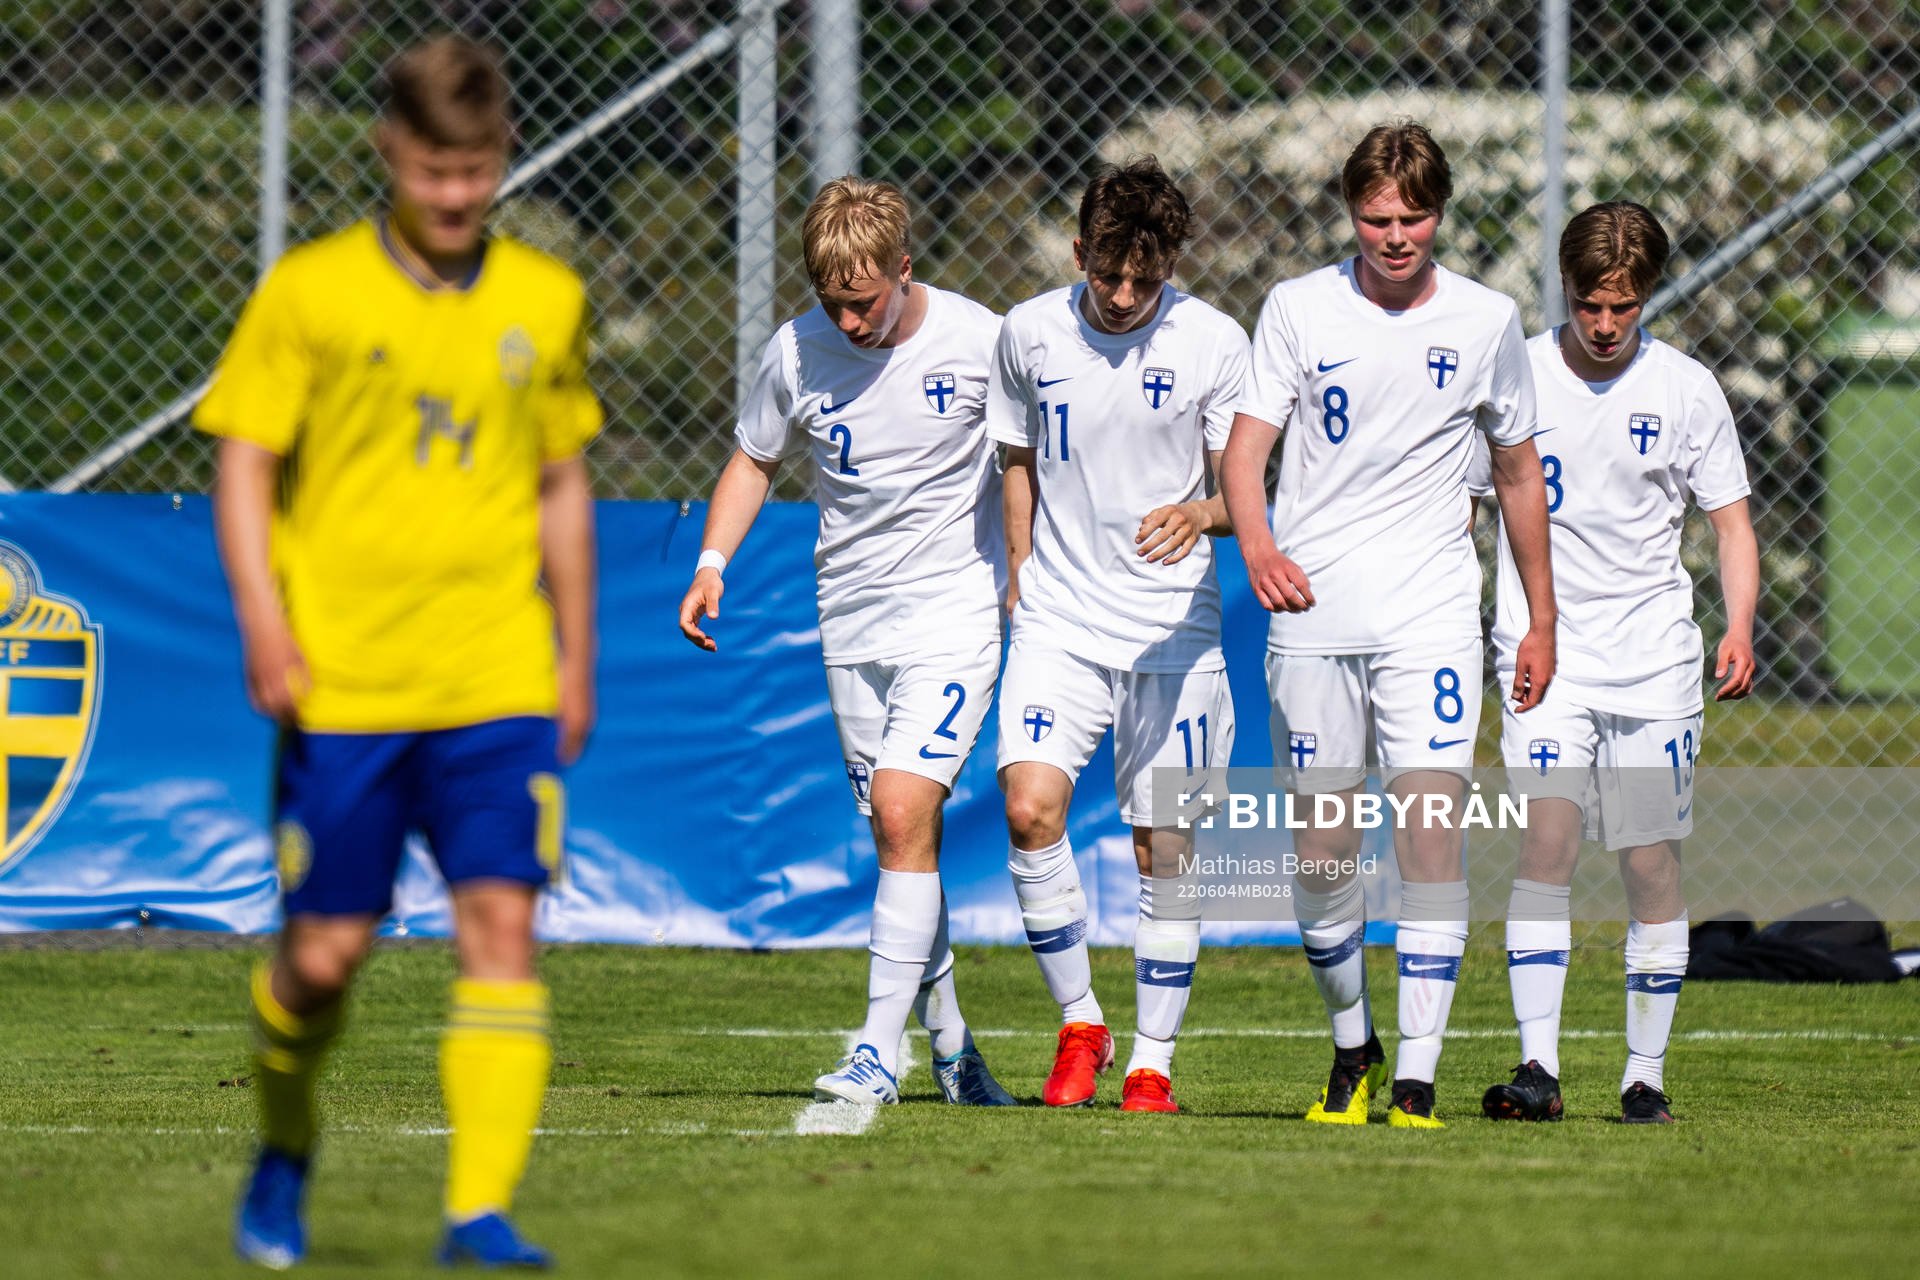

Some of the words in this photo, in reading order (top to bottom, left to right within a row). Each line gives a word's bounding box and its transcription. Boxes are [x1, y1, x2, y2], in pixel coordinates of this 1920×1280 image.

[415, 392, 479, 471] 14
[1039, 401, 1069, 462] 11
[1323, 385, 1349, 445] 8
[829, 423, 860, 477] 2
[934, 682, 966, 742] 2
[1433, 667, 1464, 724] 8
[1176, 713, 1209, 777] 11
[1664, 729, 1693, 796] 13
